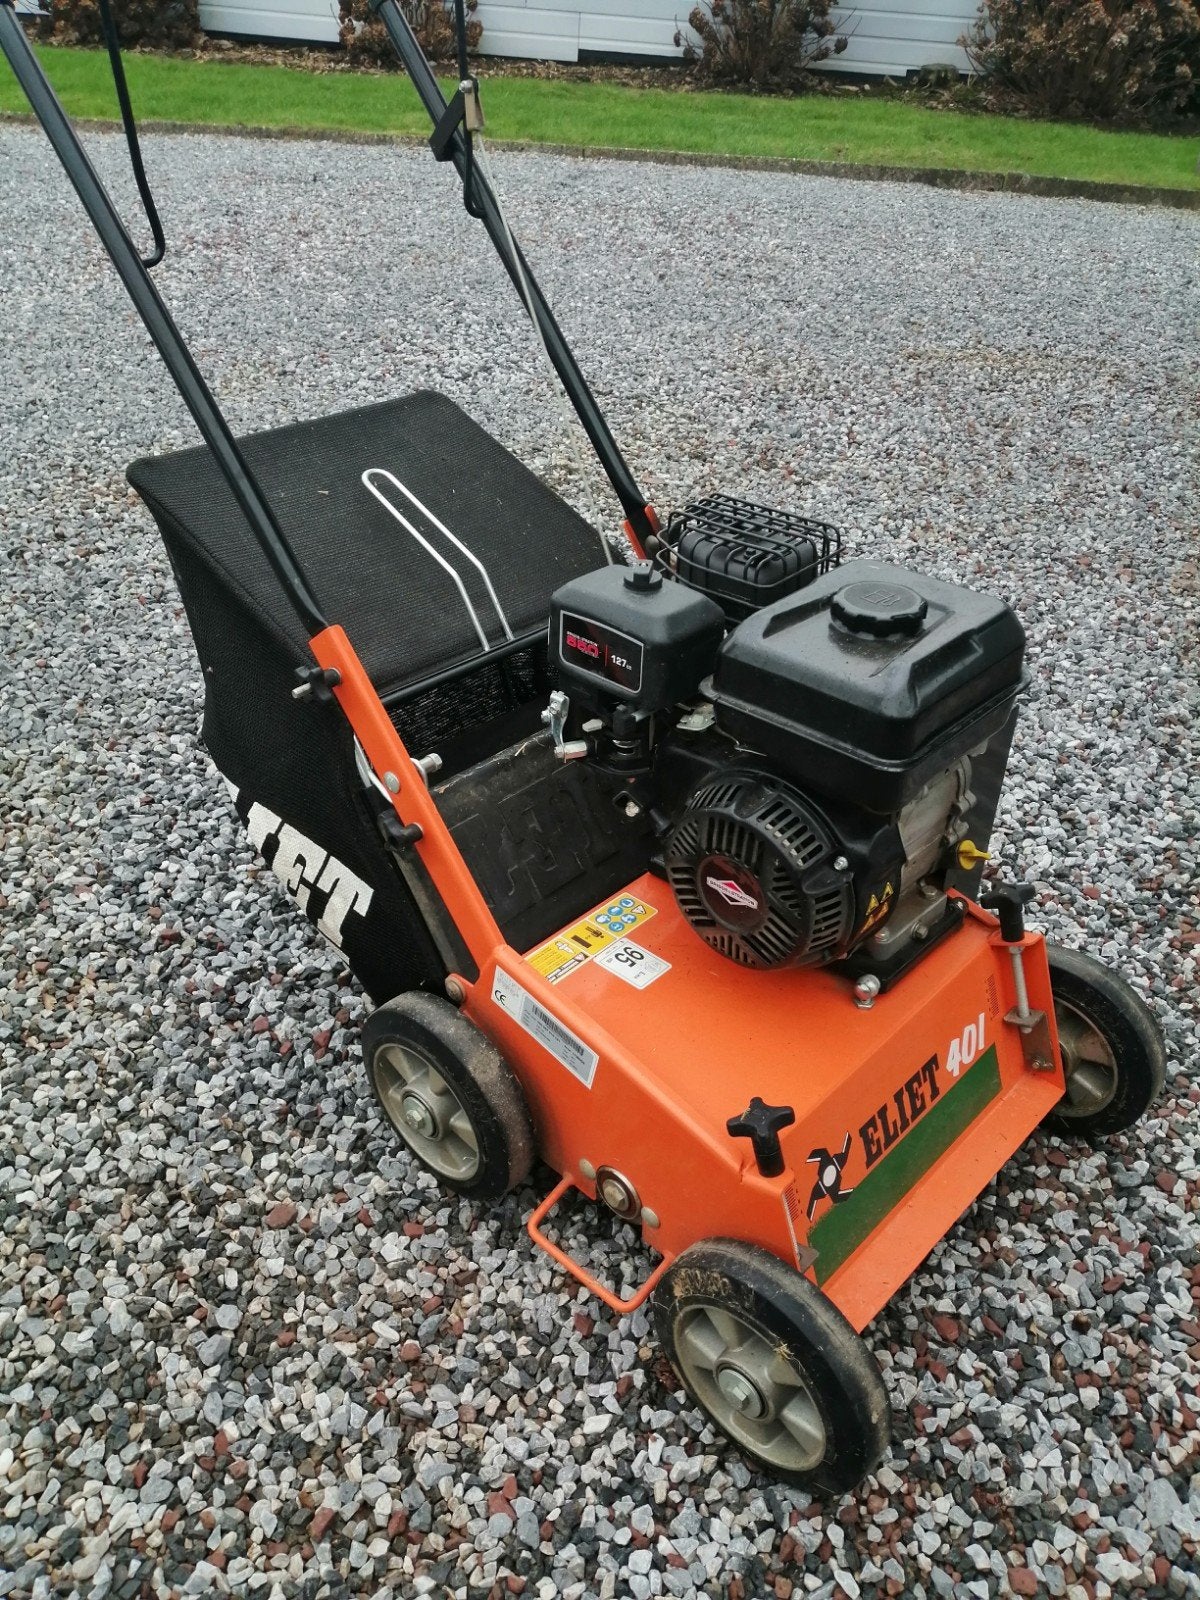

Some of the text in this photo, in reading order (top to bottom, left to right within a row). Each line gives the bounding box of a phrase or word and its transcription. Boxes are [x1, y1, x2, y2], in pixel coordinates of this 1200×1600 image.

[614, 946, 645, 968] 95
[858, 1012, 985, 1170] ELIET 401
